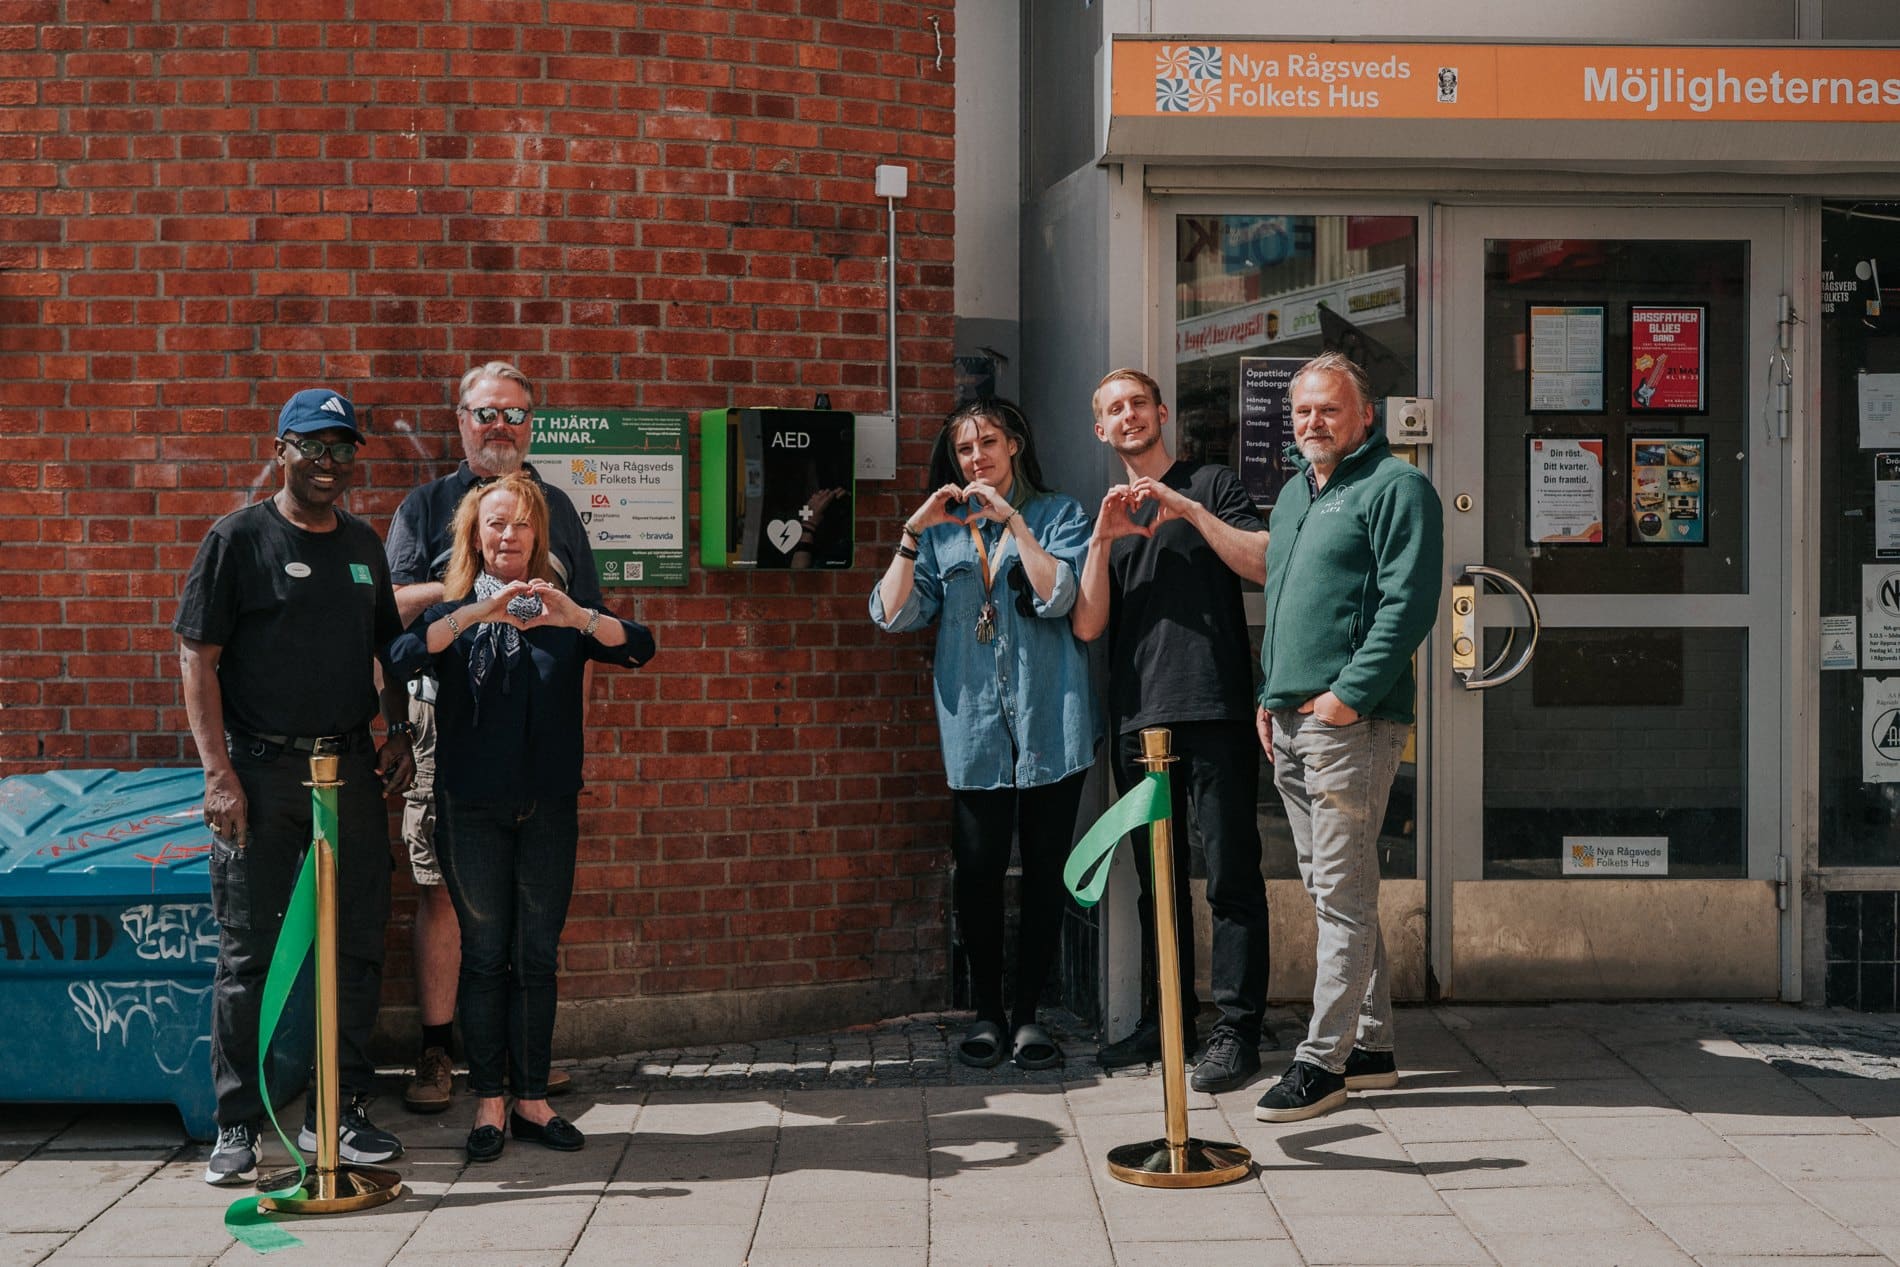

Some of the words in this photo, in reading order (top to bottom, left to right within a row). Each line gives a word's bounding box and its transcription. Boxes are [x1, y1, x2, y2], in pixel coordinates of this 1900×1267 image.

[1229, 53, 1280, 82] Nya
[1288, 52, 1411, 83] Rågsveds
[1583, 67, 1900, 112] Möjligheternas
[1229, 83, 1321, 107] Folkets
[1329, 84, 1380, 108] Hus
[1822, 292, 1849, 302] OLKETS
[1633, 312, 1698, 323] BASSFATHER
[1649, 323, 1681, 333] BLUES
[1653, 334, 1674, 342] BAND
[1246, 368, 1291, 379] Öppettider
[1246, 397, 1271, 405] Måndag
[550, 415, 609, 430] HJÄRTA
[1246, 420, 1270, 428] Onsdag
[771, 432, 810, 448] AED
[1246, 440, 1270, 448] Torsdag
[1550, 449, 1563, 457] Din
[1565, 449, 1583, 457] röst.
[1245, 456, 1267, 464] Fredag
[600, 461, 620, 474] Nya
[623, 461, 674, 475] Rågsveds
[1543, 462, 1557, 470] Ditt
[1559, 462, 1589, 470] kvarter.
[600, 474, 637, 484] Folkets
[640, 474, 661, 484] Hus
[1543, 475, 1557, 483] Din
[1559, 475, 1589, 484] framtid.
[591, 494, 610, 505] ICA
[646, 531, 673, 540] bravida
[1597, 847, 1614, 858] Nya
[1617, 847, 1661, 857] Rågsveds
[1597, 858, 1629, 867] Folkets
[1631, 858, 1650, 867] Hus
